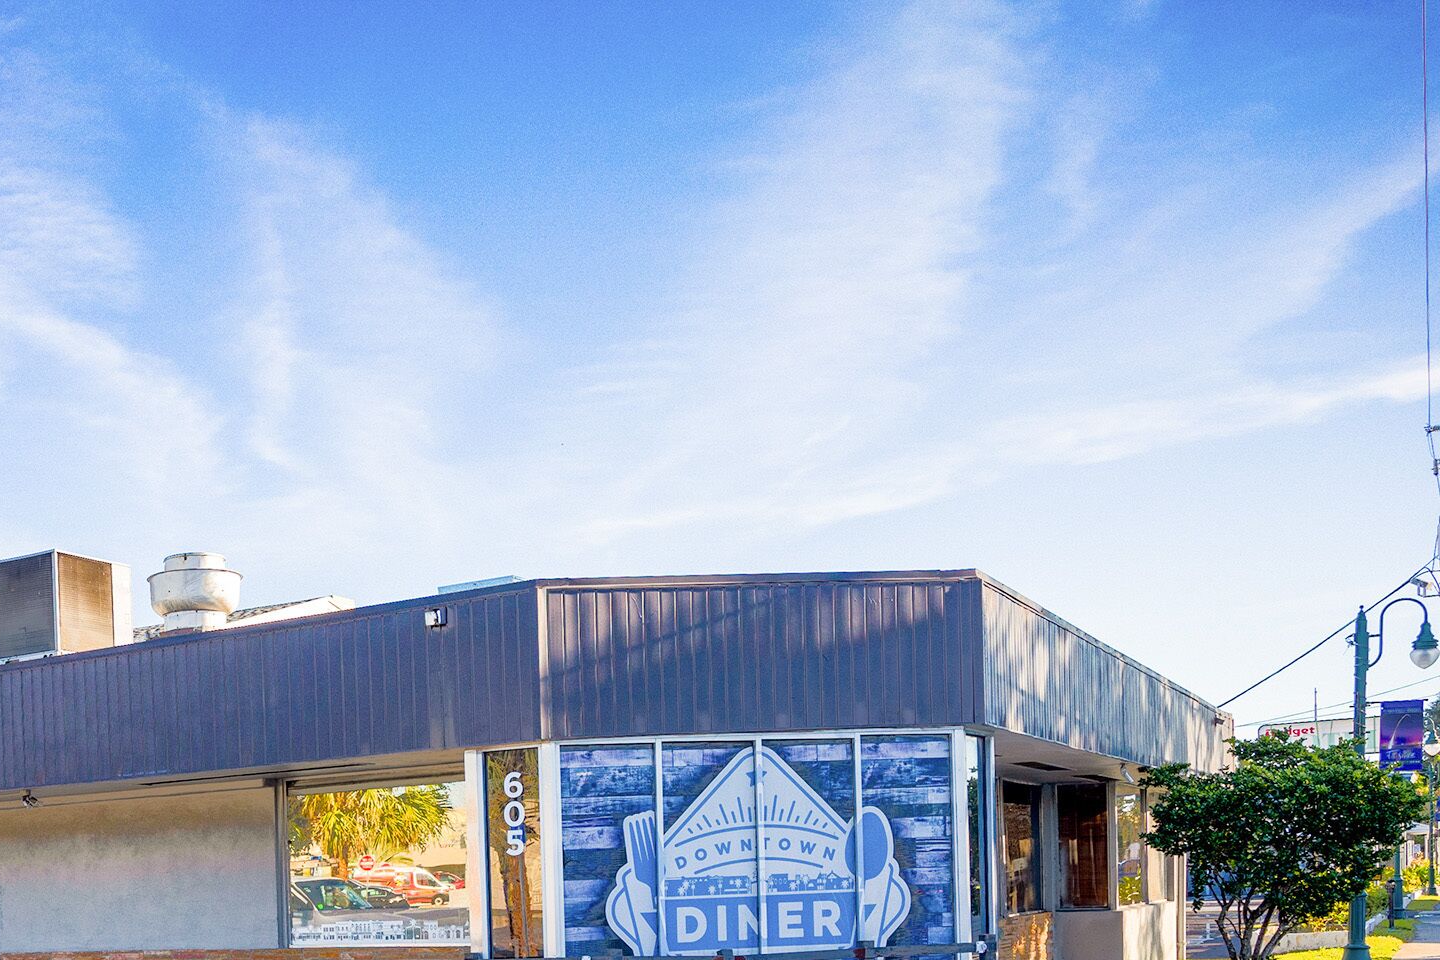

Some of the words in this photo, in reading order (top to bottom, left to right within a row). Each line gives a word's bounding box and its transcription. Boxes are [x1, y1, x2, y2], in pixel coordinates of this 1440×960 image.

[503, 771, 526, 856] 605
[674, 838, 836, 870] DOWNTOWN
[676, 900, 842, 944] DINER
